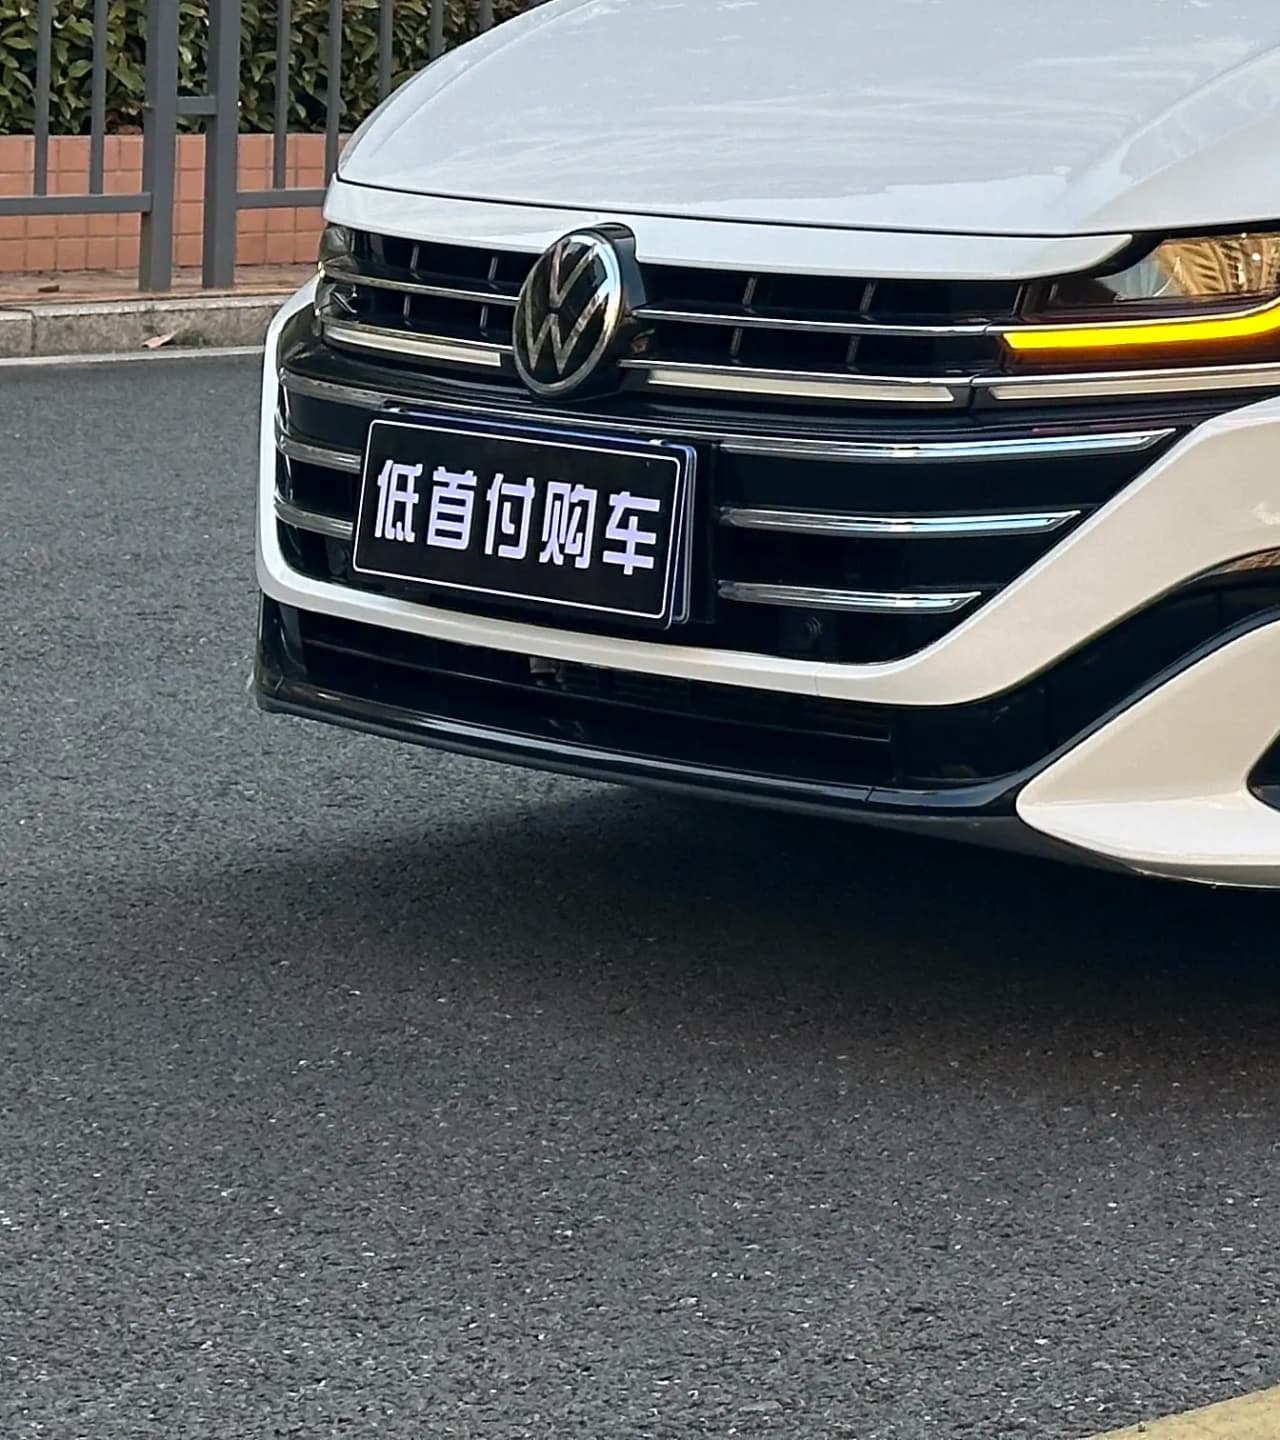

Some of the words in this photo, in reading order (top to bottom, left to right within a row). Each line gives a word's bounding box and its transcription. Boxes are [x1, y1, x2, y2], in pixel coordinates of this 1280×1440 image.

[374, 459, 662, 576] 低首付购车
